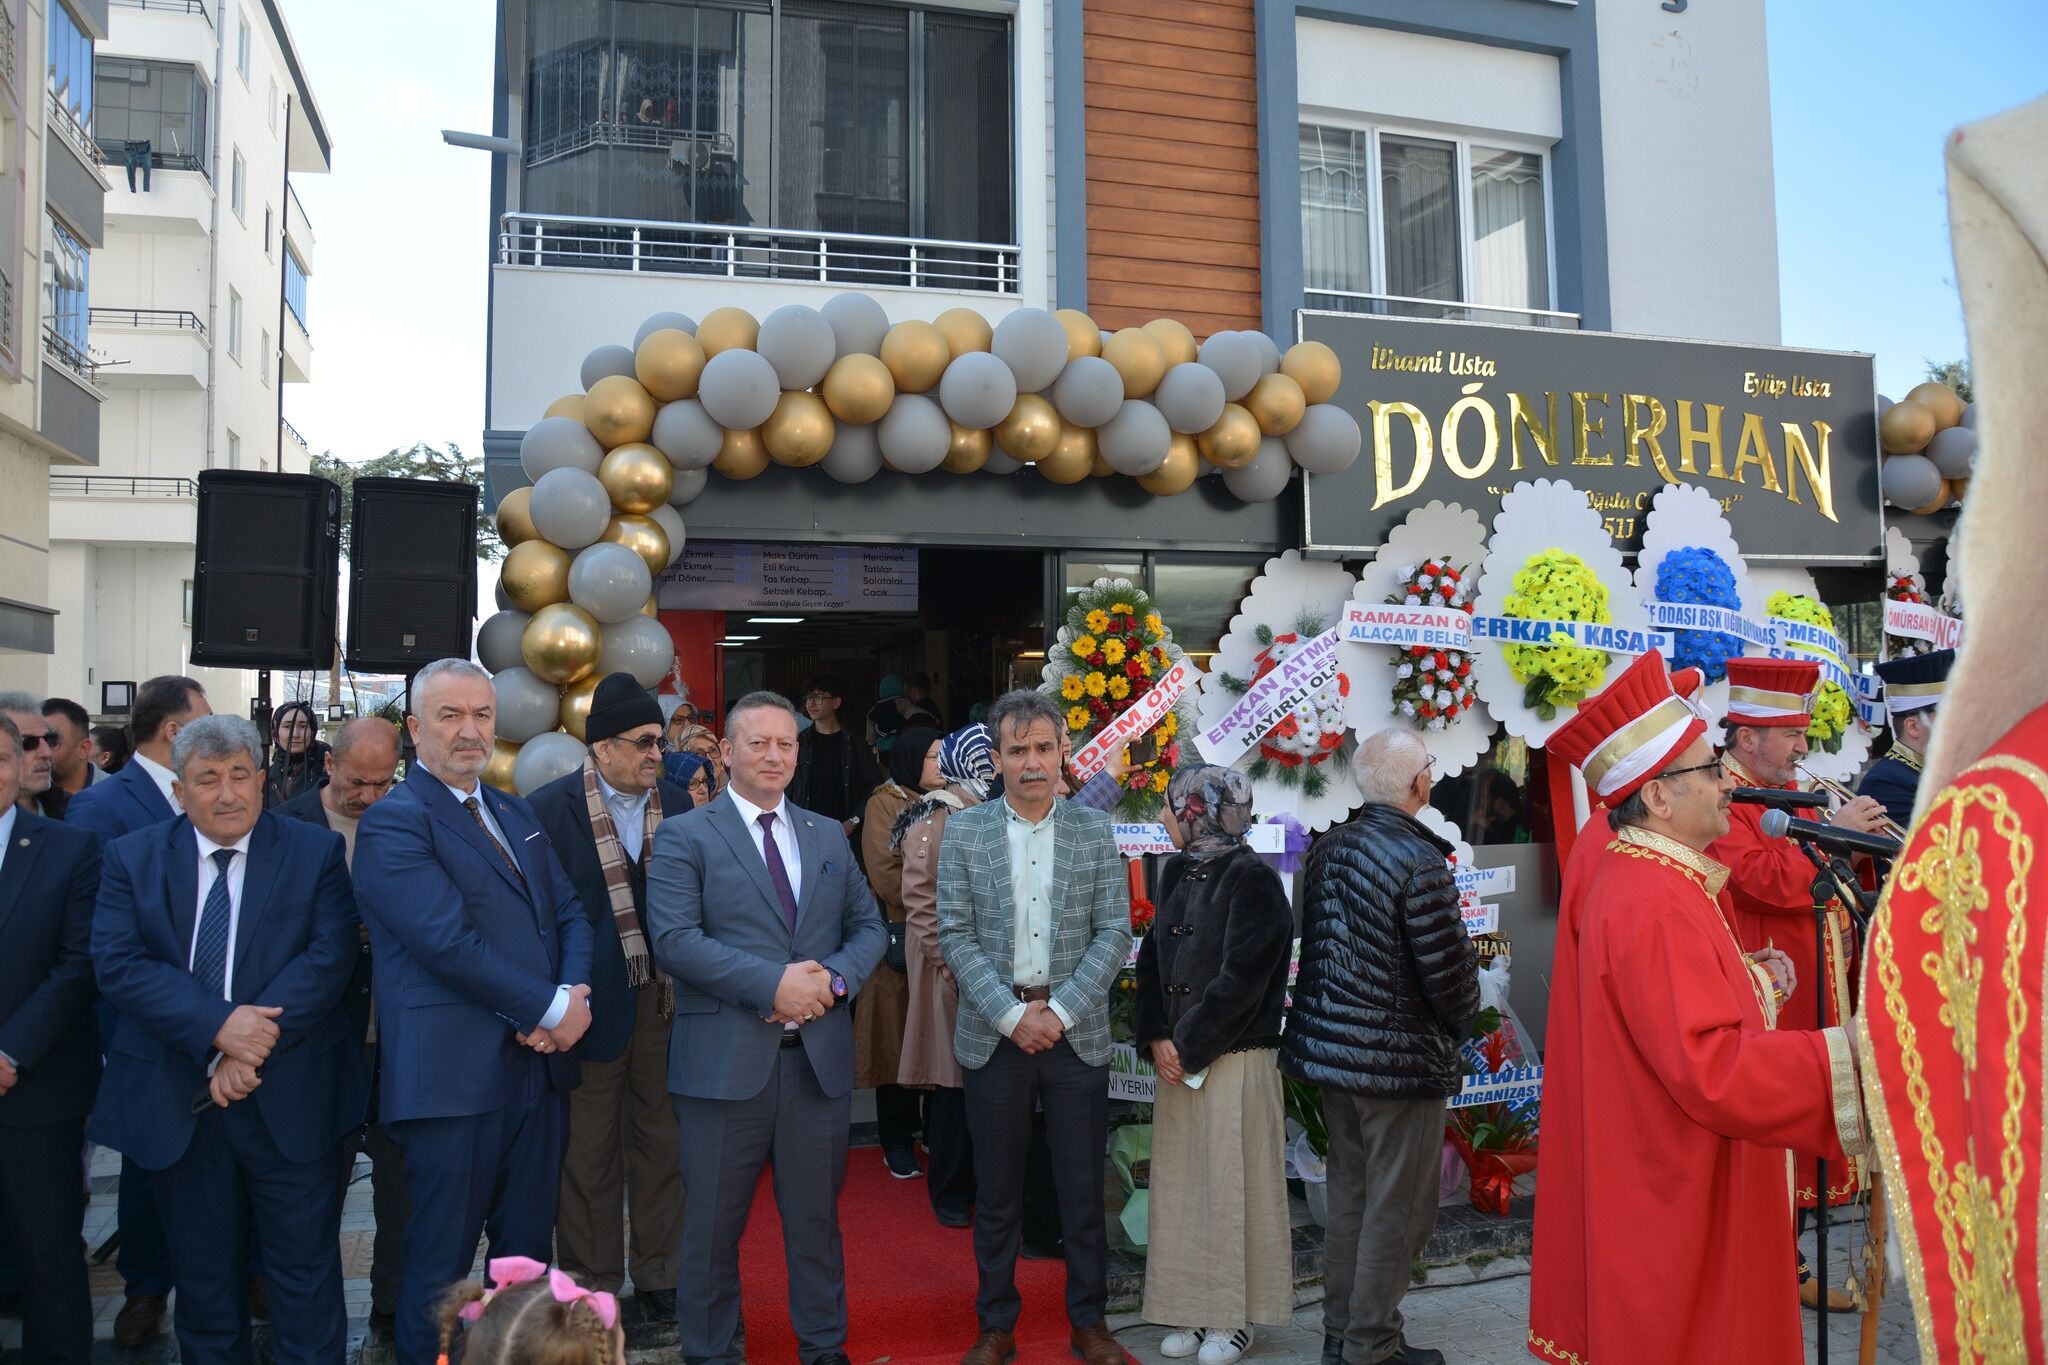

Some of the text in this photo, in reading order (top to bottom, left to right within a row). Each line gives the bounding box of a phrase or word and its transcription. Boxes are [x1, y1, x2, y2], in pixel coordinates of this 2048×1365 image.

[1448, 352, 1497, 377] Usta
[1743, 372, 1832, 399] Eyüp Usta
[684, 562, 713, 571] Ekmek
[863, 553, 905, 562] Mercimek
[763, 563, 800, 572] Etli Kuru
[678, 573, 706, 582] Döner
[763, 575, 810, 585] Tas Kebap
[763, 587, 826, 597] Sebzeli Kebap
[1349, 610, 1449, 628] RAMAZAN
[1658, 605, 1696, 626] ODASI
[1349, 625, 1418, 642] ALAÇAM
[1584, 624, 1666, 652] KASAP
[1146, 666, 1184, 708] OTO
[1206, 676, 1279, 746] ERKAN
[1240, 702, 1272, 729] VE
[1241, 687, 1309, 747] HAYIRLI
